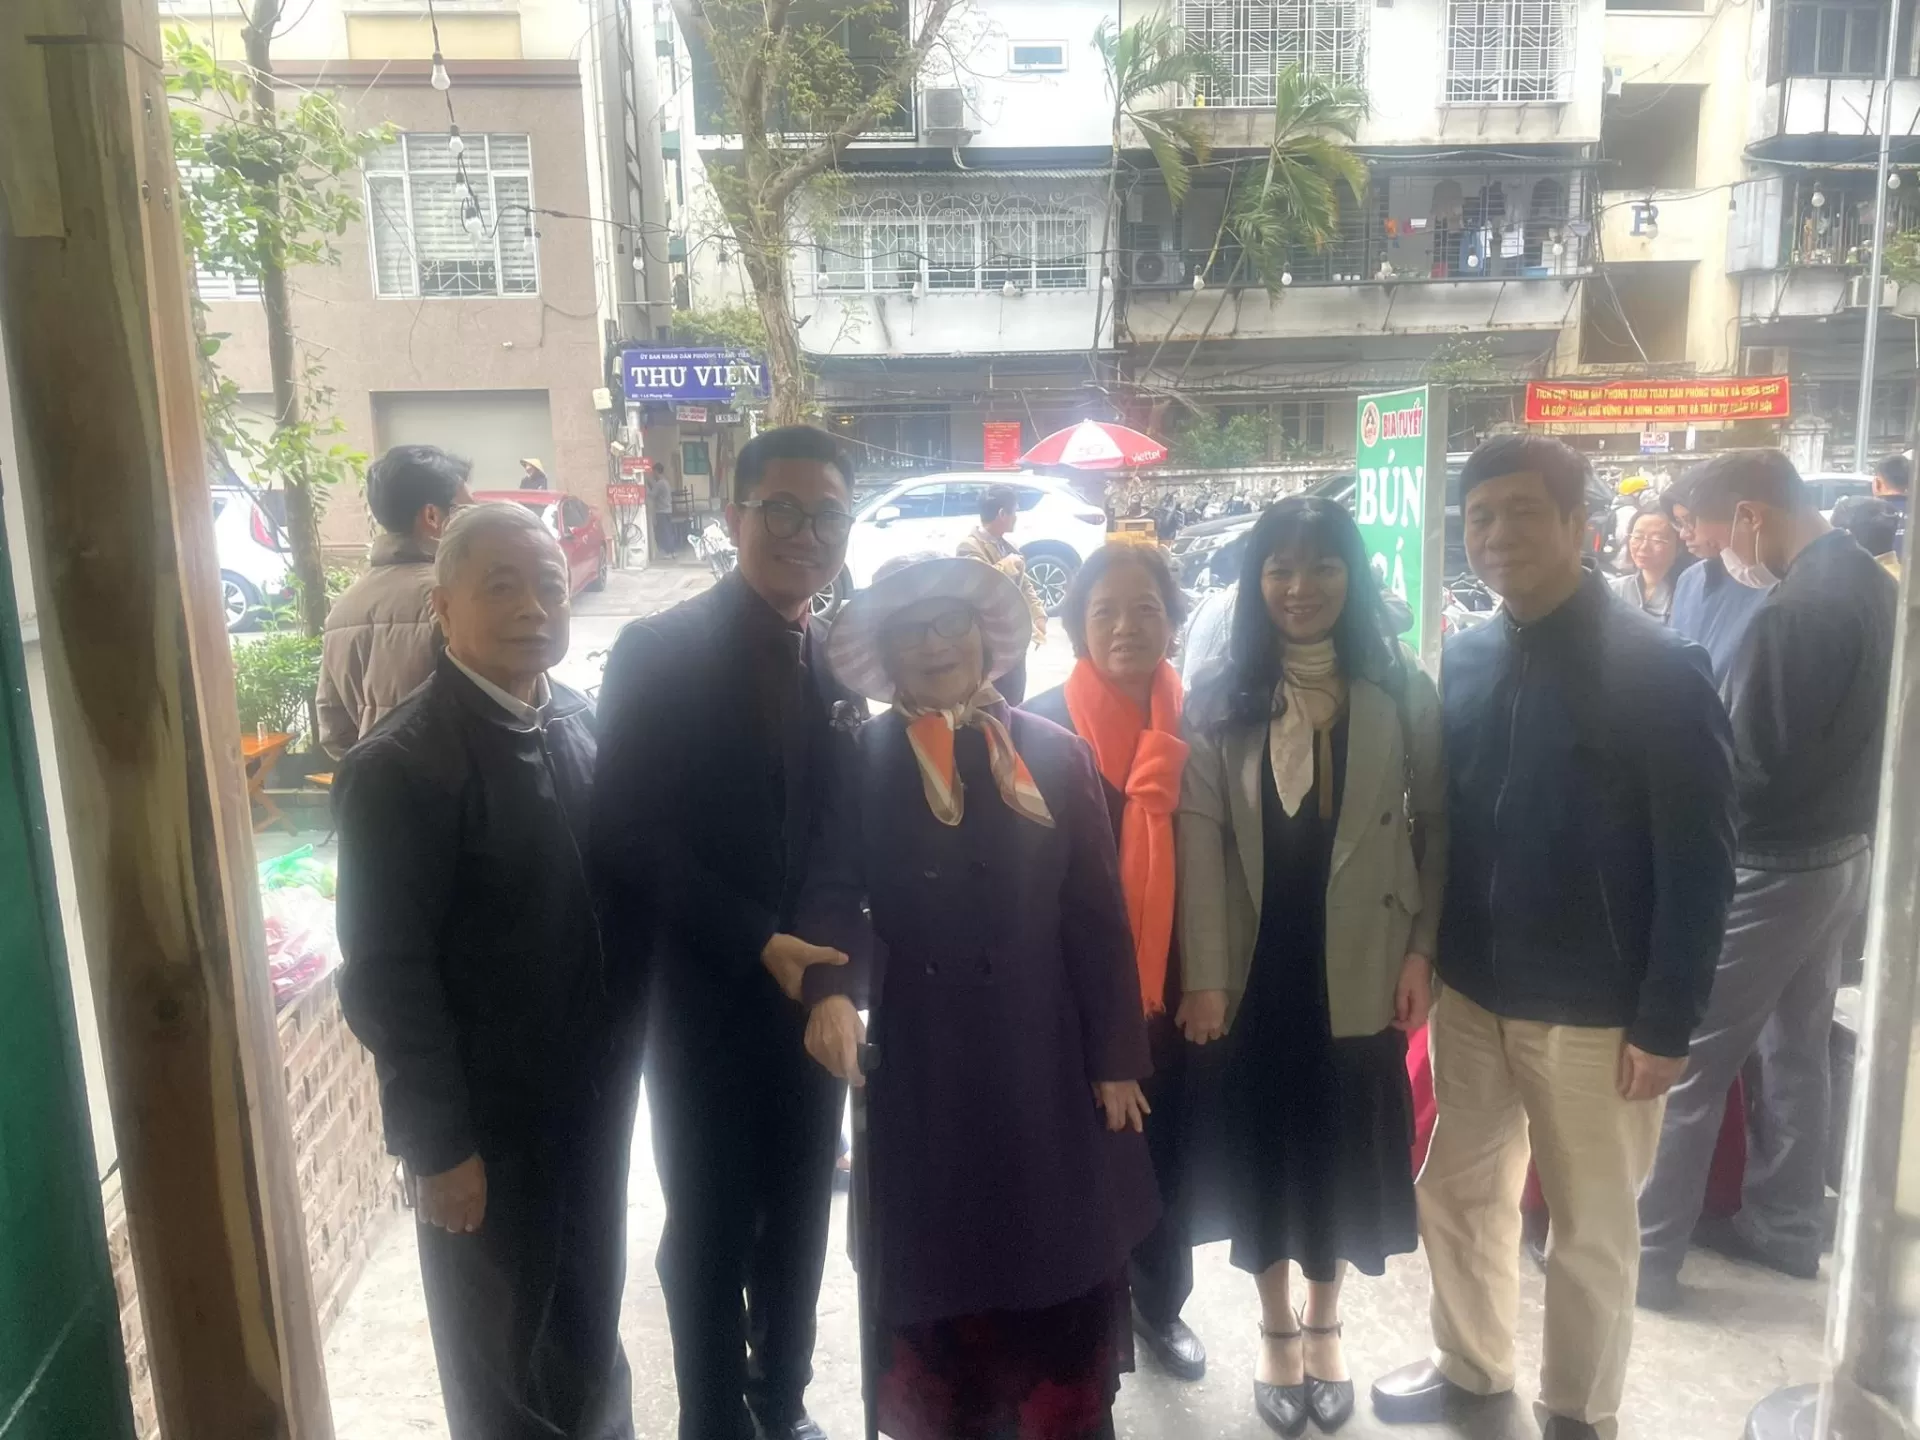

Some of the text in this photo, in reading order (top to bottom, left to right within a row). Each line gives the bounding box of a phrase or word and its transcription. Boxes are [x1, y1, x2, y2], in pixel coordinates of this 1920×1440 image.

[631, 360, 761, 391] THƯ VIỆN
[1570, 388, 1589, 399] THAM
[1604, 388, 1628, 399] PHONG
[1541, 404, 1550, 416] LÀ
[1623, 404, 1634, 416] AN
[1635, 404, 1653, 416] NINH
[1132, 450, 1161, 462] viettel
[1358, 447, 1423, 528] BÚN
